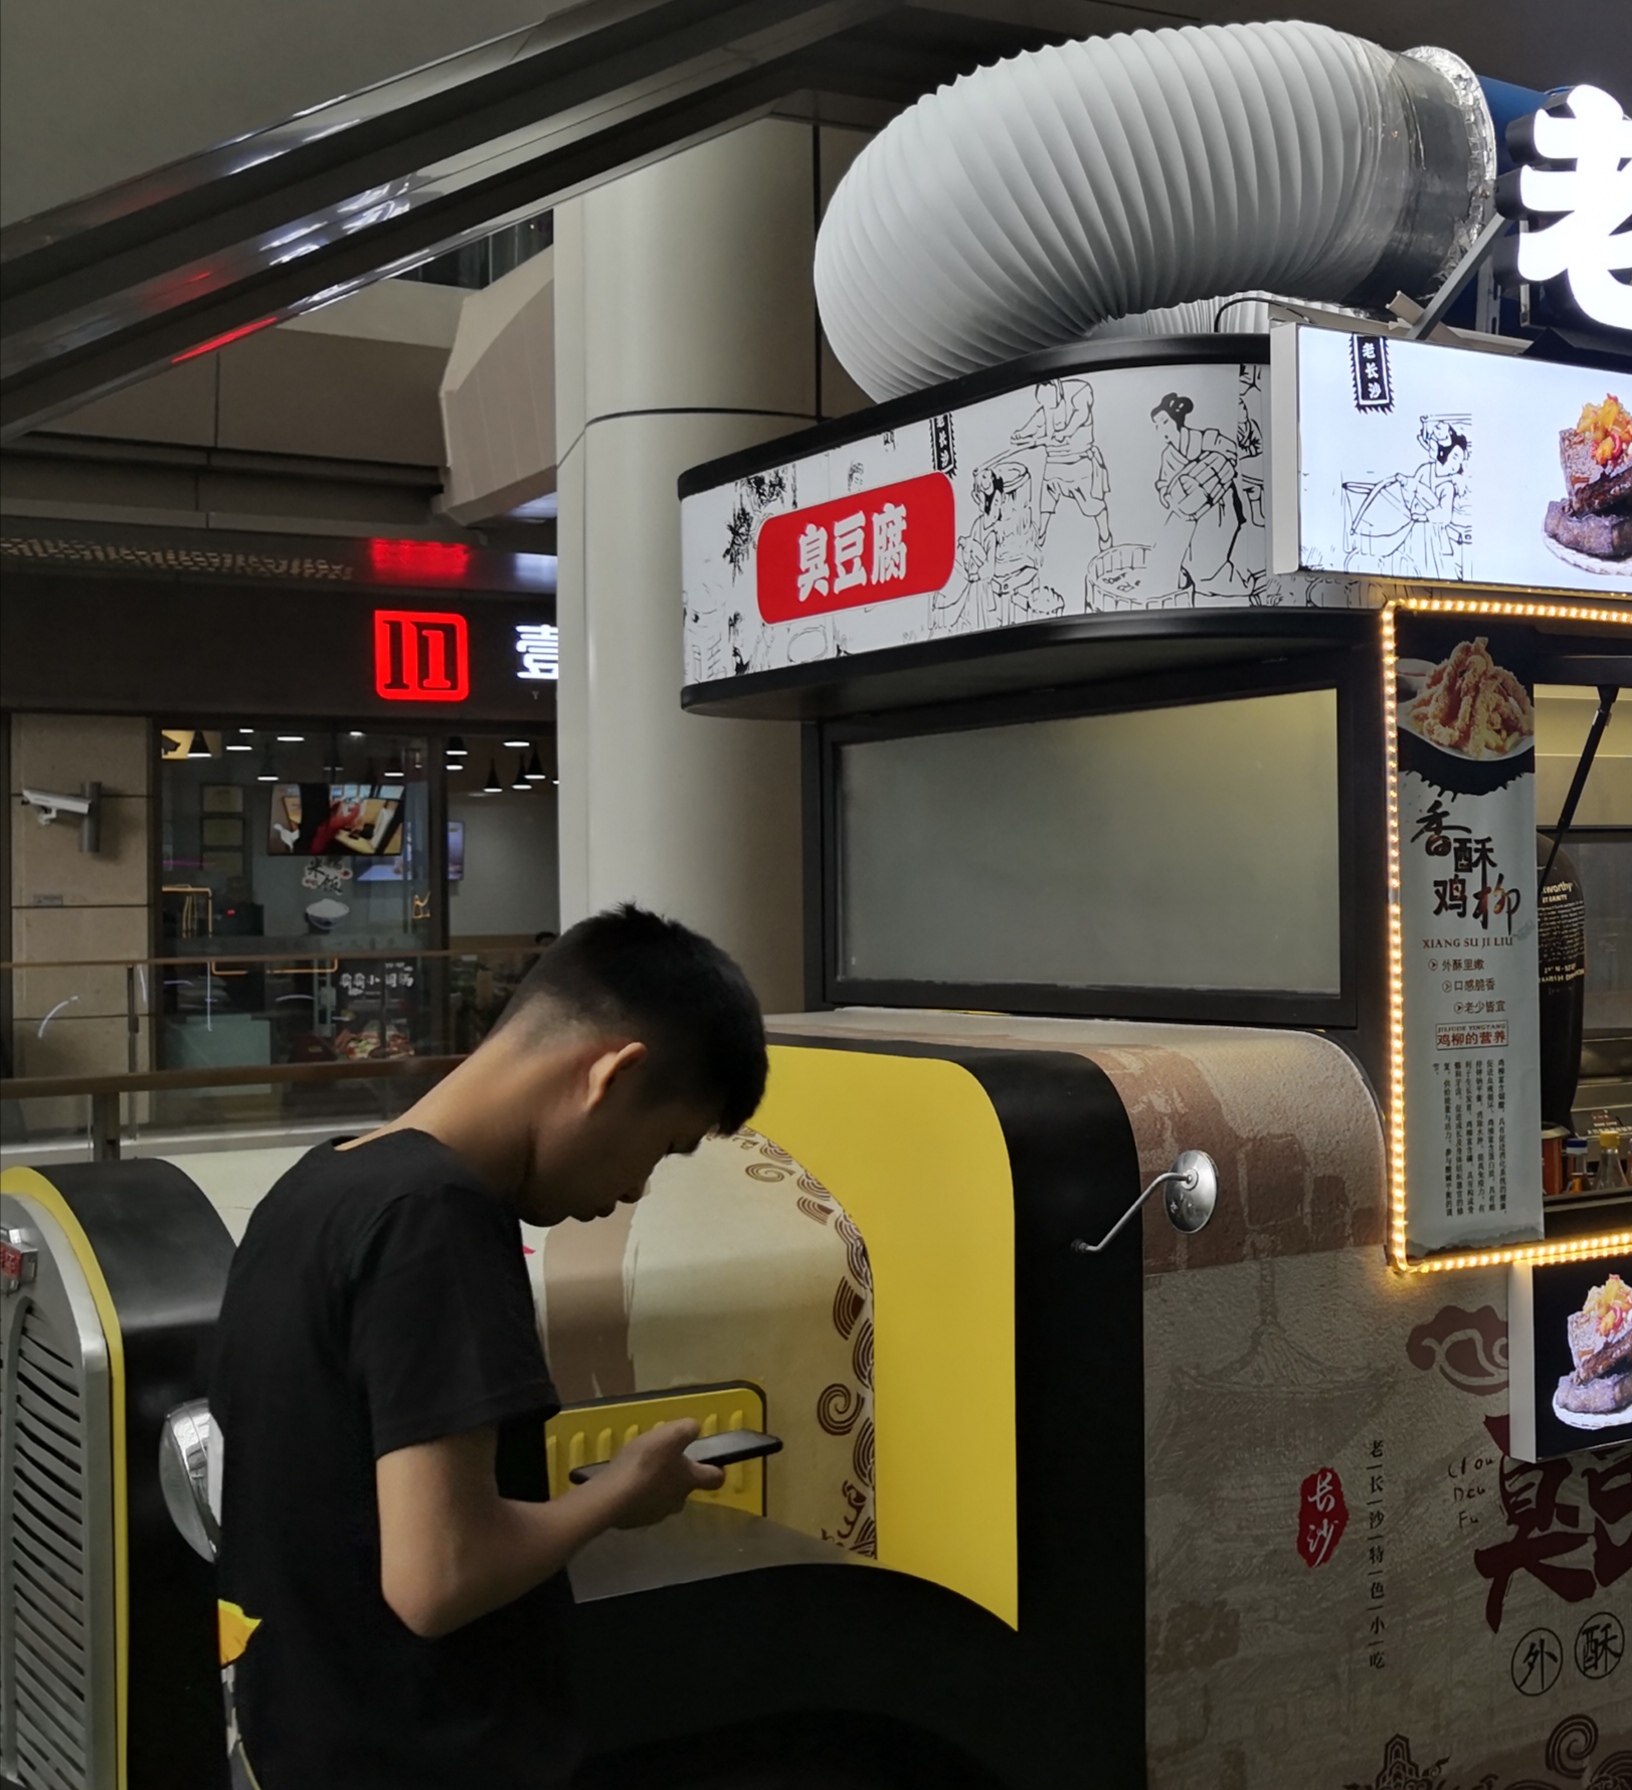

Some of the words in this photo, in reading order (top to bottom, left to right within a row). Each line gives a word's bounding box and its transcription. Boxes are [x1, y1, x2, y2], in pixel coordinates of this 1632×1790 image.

[1362, 342, 1382, 399] 老长沙
[797, 503, 908, 602] 臭豆腐
[1422, 938, 1461, 949] XIANG
[1463, 937, 1479, 948] SU
[1493, 937, 1514, 947] LIU
[1437, 1031, 1506, 1047] 鸡柳的营养
[1306, 1468, 1338, 1567] 长沙
[1459, 1509, 1480, 1529] Fu
